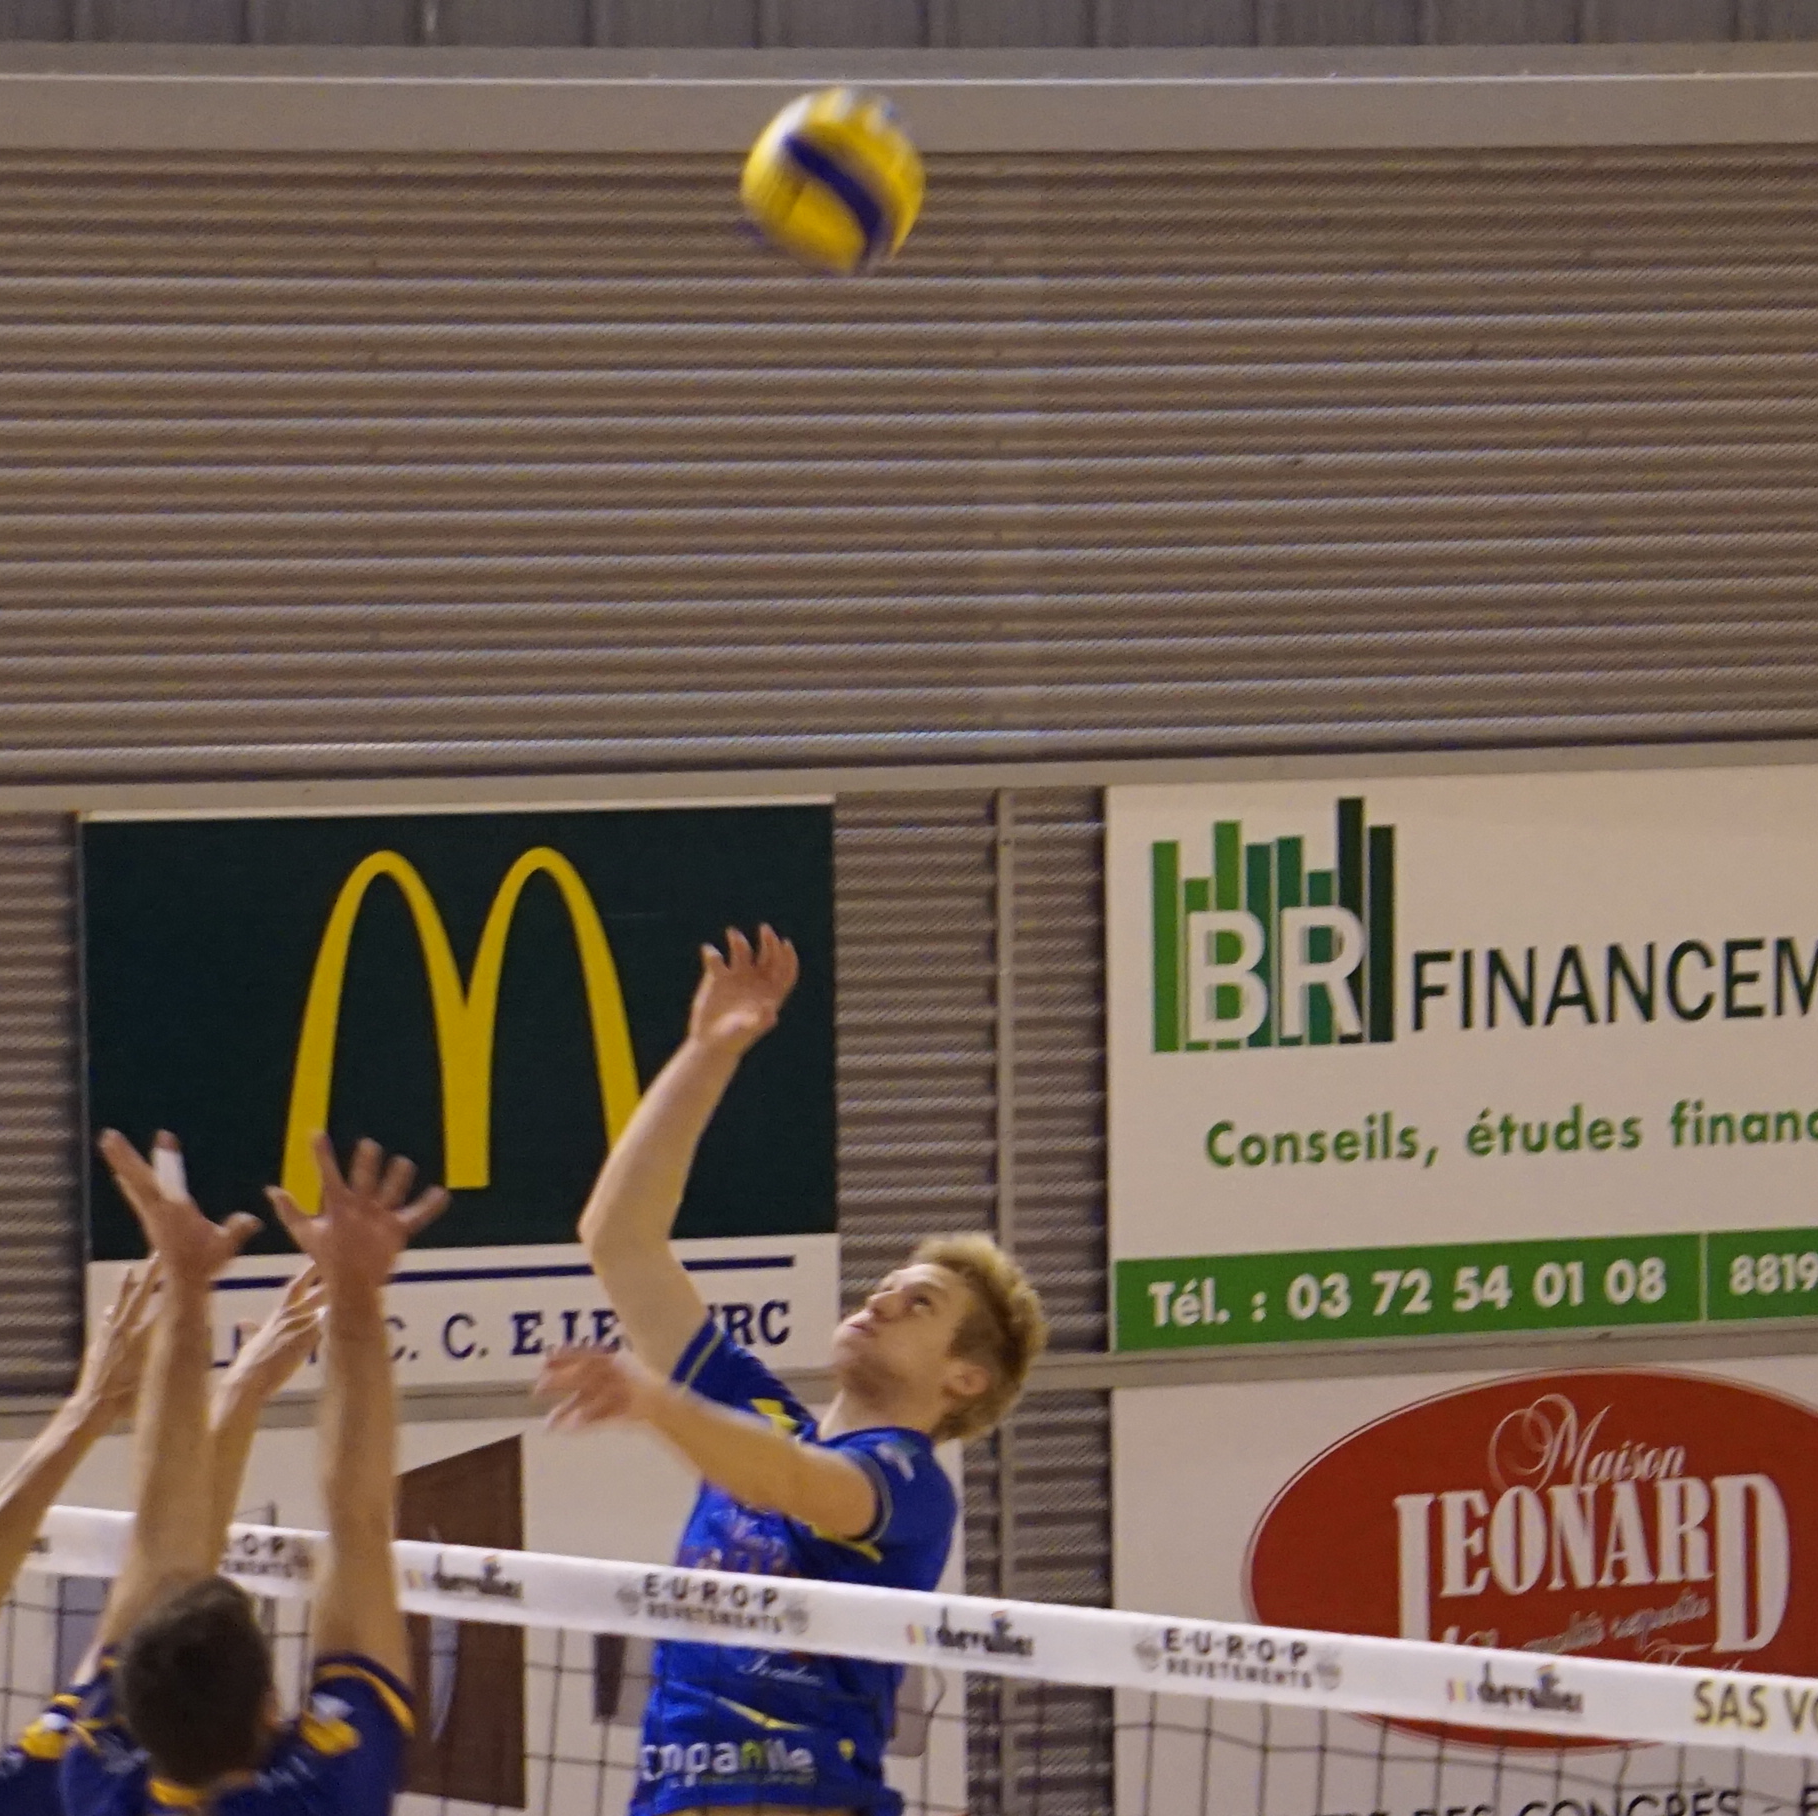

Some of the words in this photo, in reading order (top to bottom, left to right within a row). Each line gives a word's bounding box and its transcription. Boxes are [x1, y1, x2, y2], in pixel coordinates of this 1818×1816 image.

[1186, 906, 1366, 1044] BR
[1205, 1110, 1438, 1170] Conseils,
[1465, 1102, 1643, 1158] études
[512, 1299, 793, 1357] E.LERC
[1148, 1280, 1229, 1329] Tél.
[1286, 1273, 1351, 1321] 03
[1370, 1269, 1433, 1318] 72
[1452, 1266, 1513, 1312] 54
[1532, 1262, 1584, 1309] 01
[1602, 1258, 1667, 1305] 08
[1488, 1393, 1686, 1493] Maison
[1393, 1473, 1791, 1653] LEONARD
[1693, 1679, 1769, 1731] SAS
